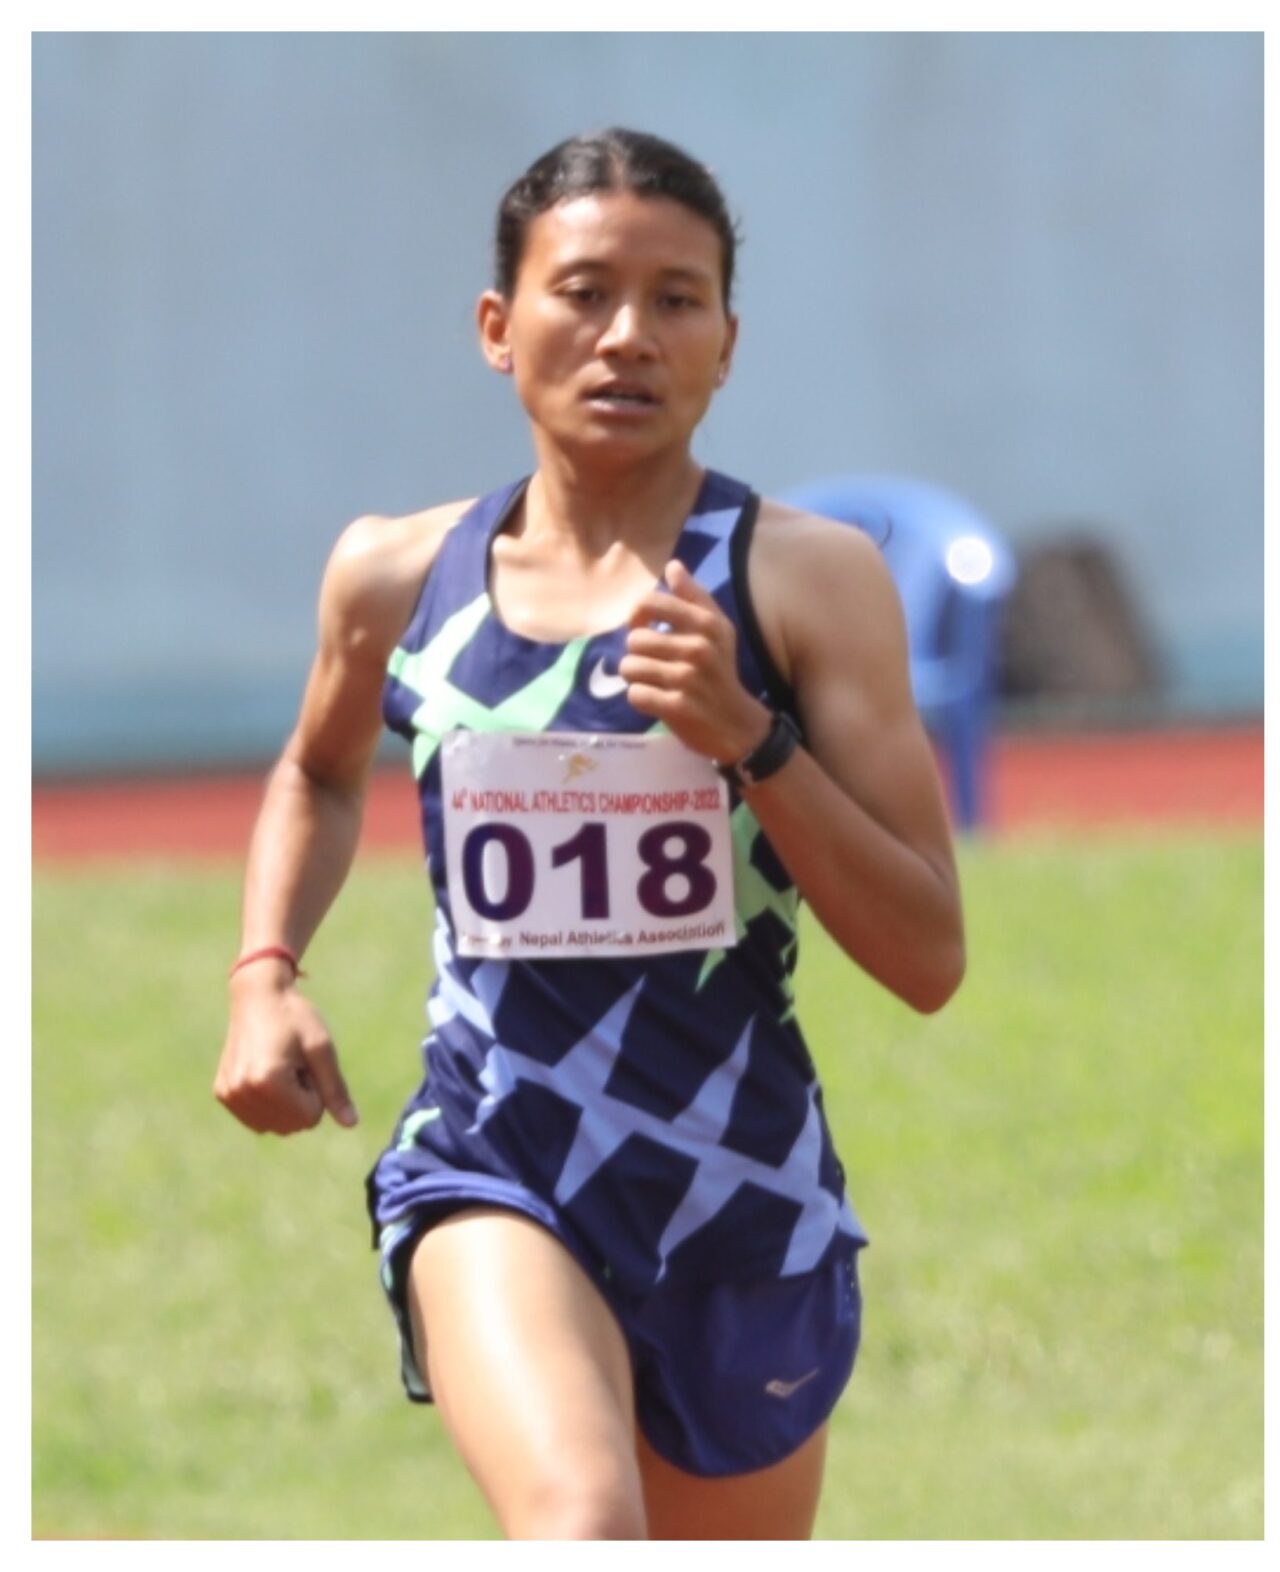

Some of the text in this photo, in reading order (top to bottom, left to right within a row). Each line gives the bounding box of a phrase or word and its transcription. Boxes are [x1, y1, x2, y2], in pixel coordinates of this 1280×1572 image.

[471, 790, 528, 813] NATIONAL
[532, 791, 596, 814] ATHLETICS
[462, 820, 717, 922] 018
[520, 931, 562, 948] Nepal
[637, 921, 725, 944] Association
